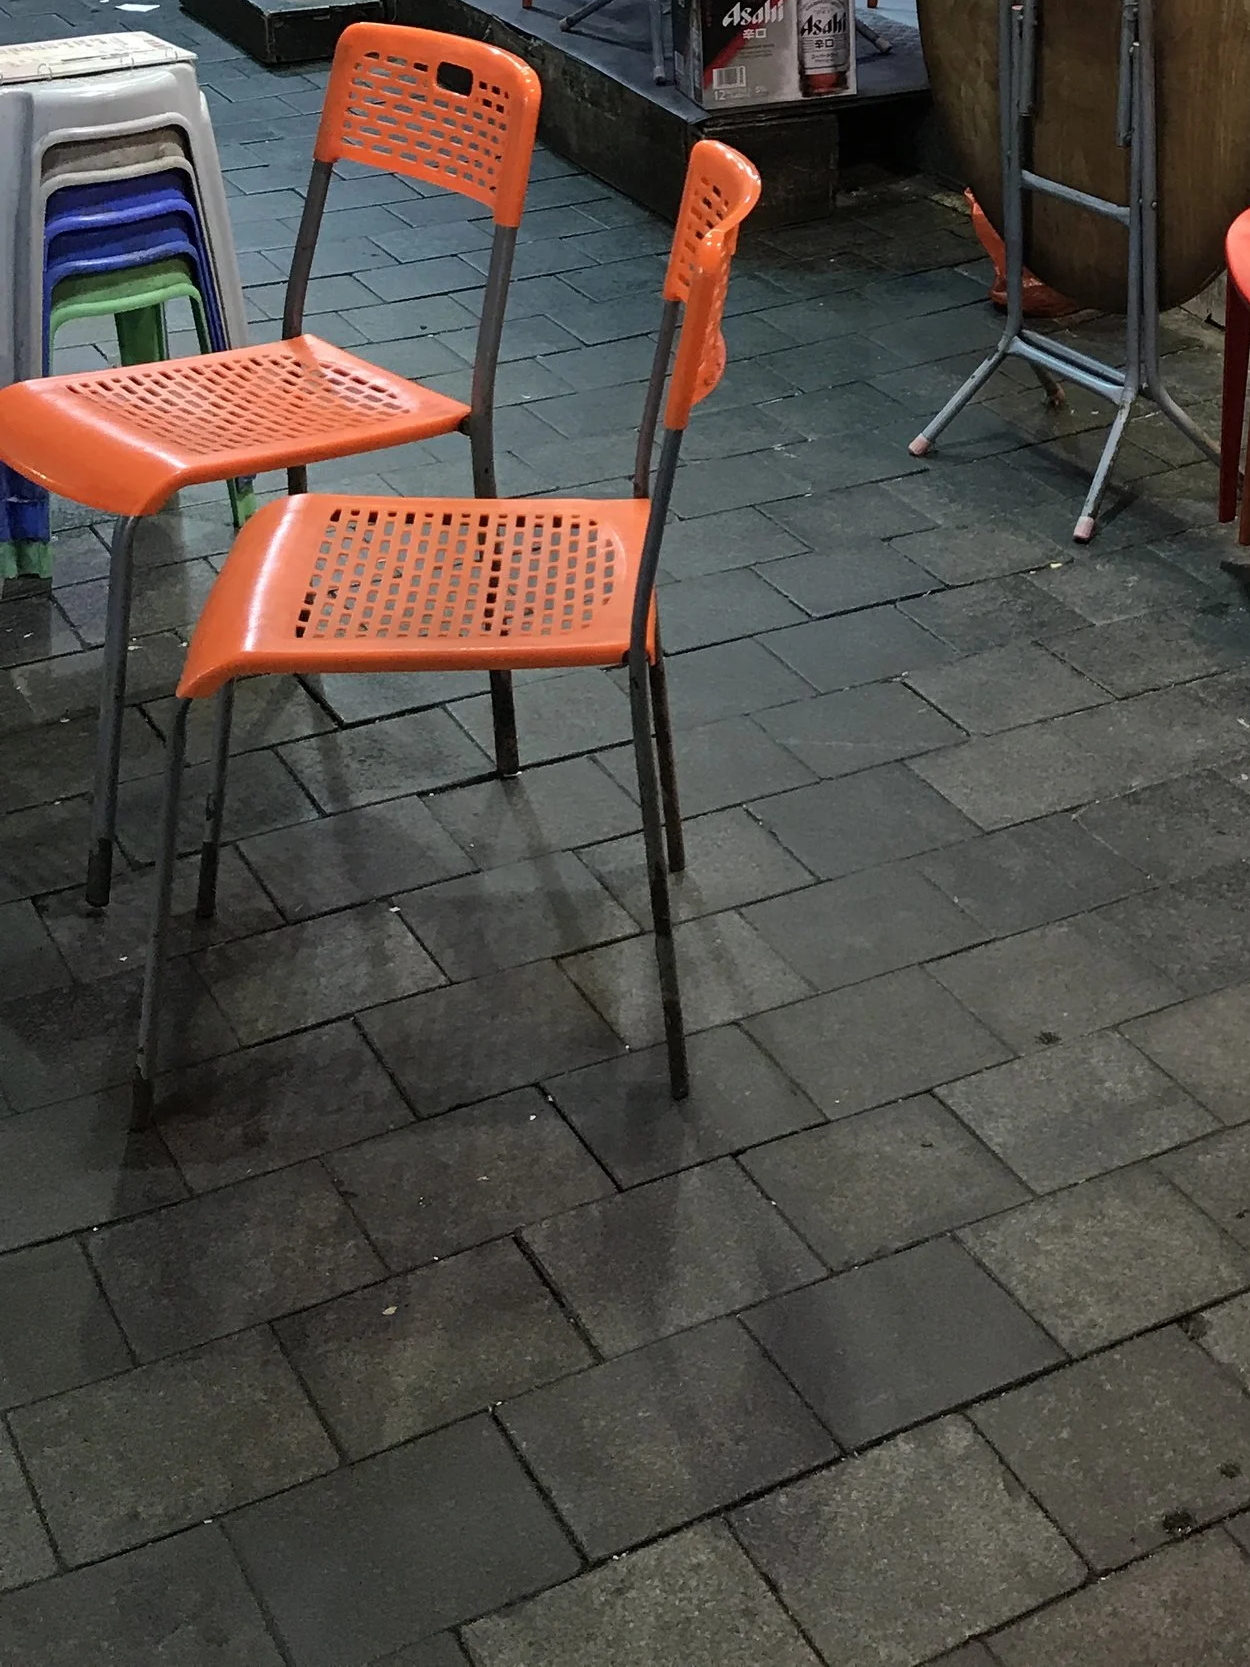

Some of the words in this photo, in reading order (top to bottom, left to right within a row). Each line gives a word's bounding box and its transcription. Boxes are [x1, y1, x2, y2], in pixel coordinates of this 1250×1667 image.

[800, 12, 846, 37] Asahi
[743, 28, 766, 39] 辛口
[814, 38, 834, 48] 辛口
[714, 90, 726, 101] 12
